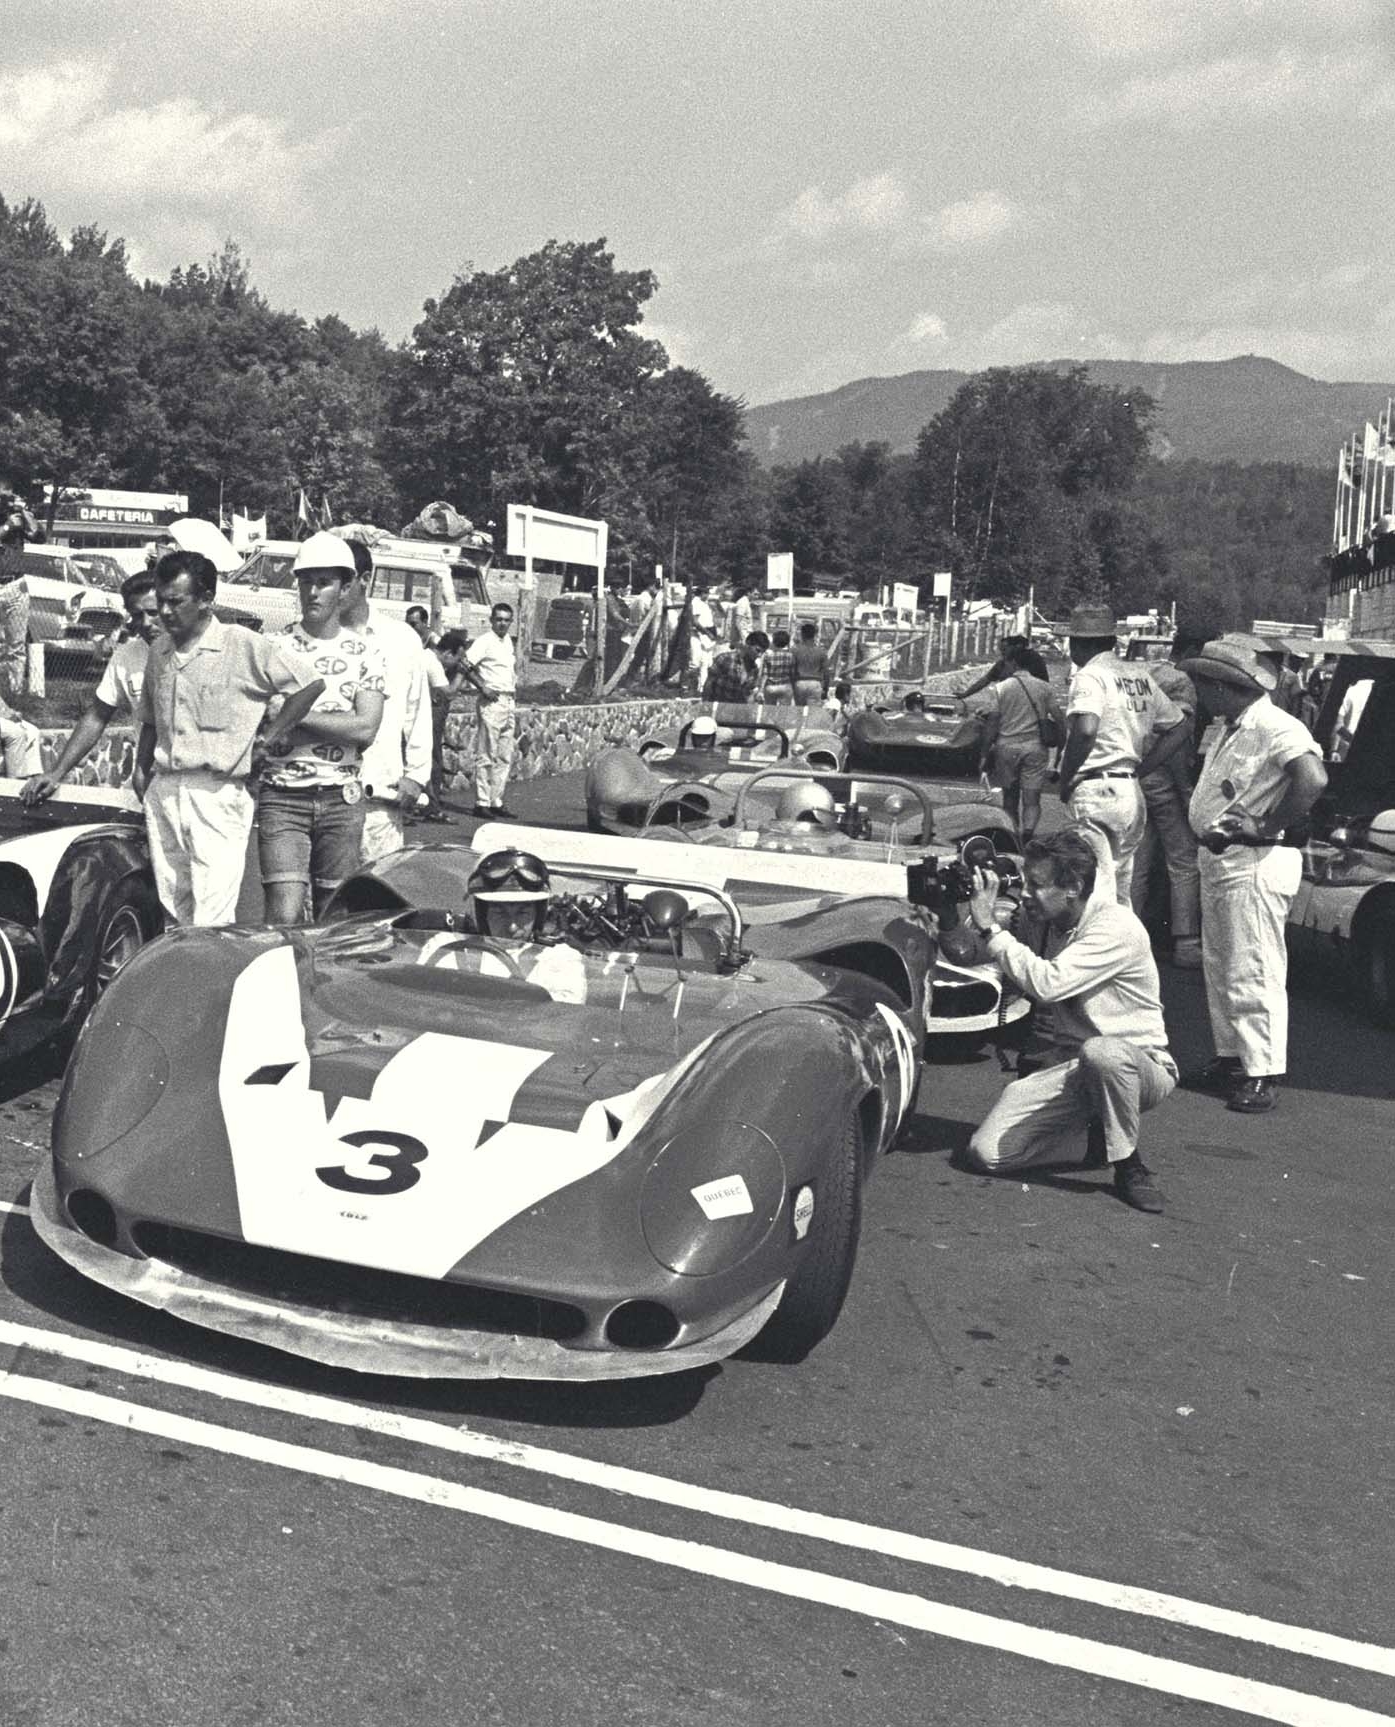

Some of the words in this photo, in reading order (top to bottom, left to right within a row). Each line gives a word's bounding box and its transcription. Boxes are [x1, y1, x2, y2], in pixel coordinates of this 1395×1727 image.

[80, 508, 154, 524] CAFETERIA
[314, 656, 348, 675] STP
[315, 1130, 429, 1195] 3
[703, 1186, 744, 1203] QUEBEC
